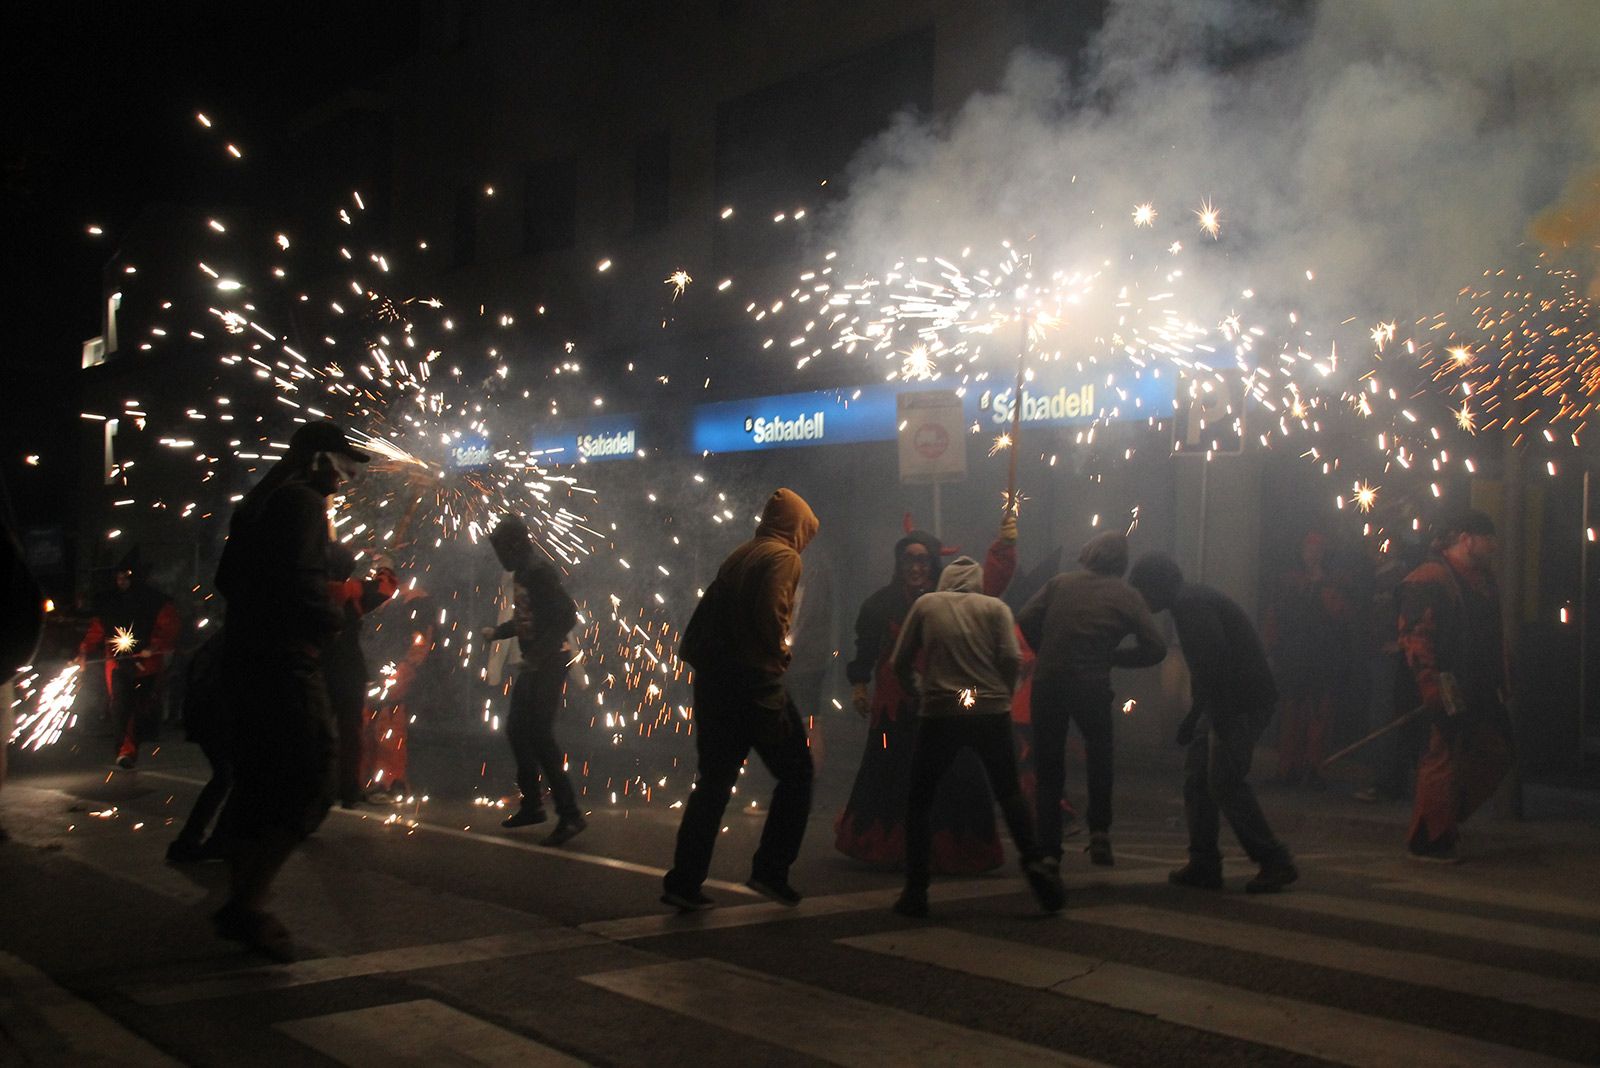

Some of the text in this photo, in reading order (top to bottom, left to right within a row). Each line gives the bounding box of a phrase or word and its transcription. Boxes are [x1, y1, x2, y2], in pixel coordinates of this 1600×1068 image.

[992, 384, 1094, 424] Sabadell
[1187, 378, 1230, 445] P
[583, 429, 635, 457] Sabadell
[753, 411, 824, 443] Sabadell
